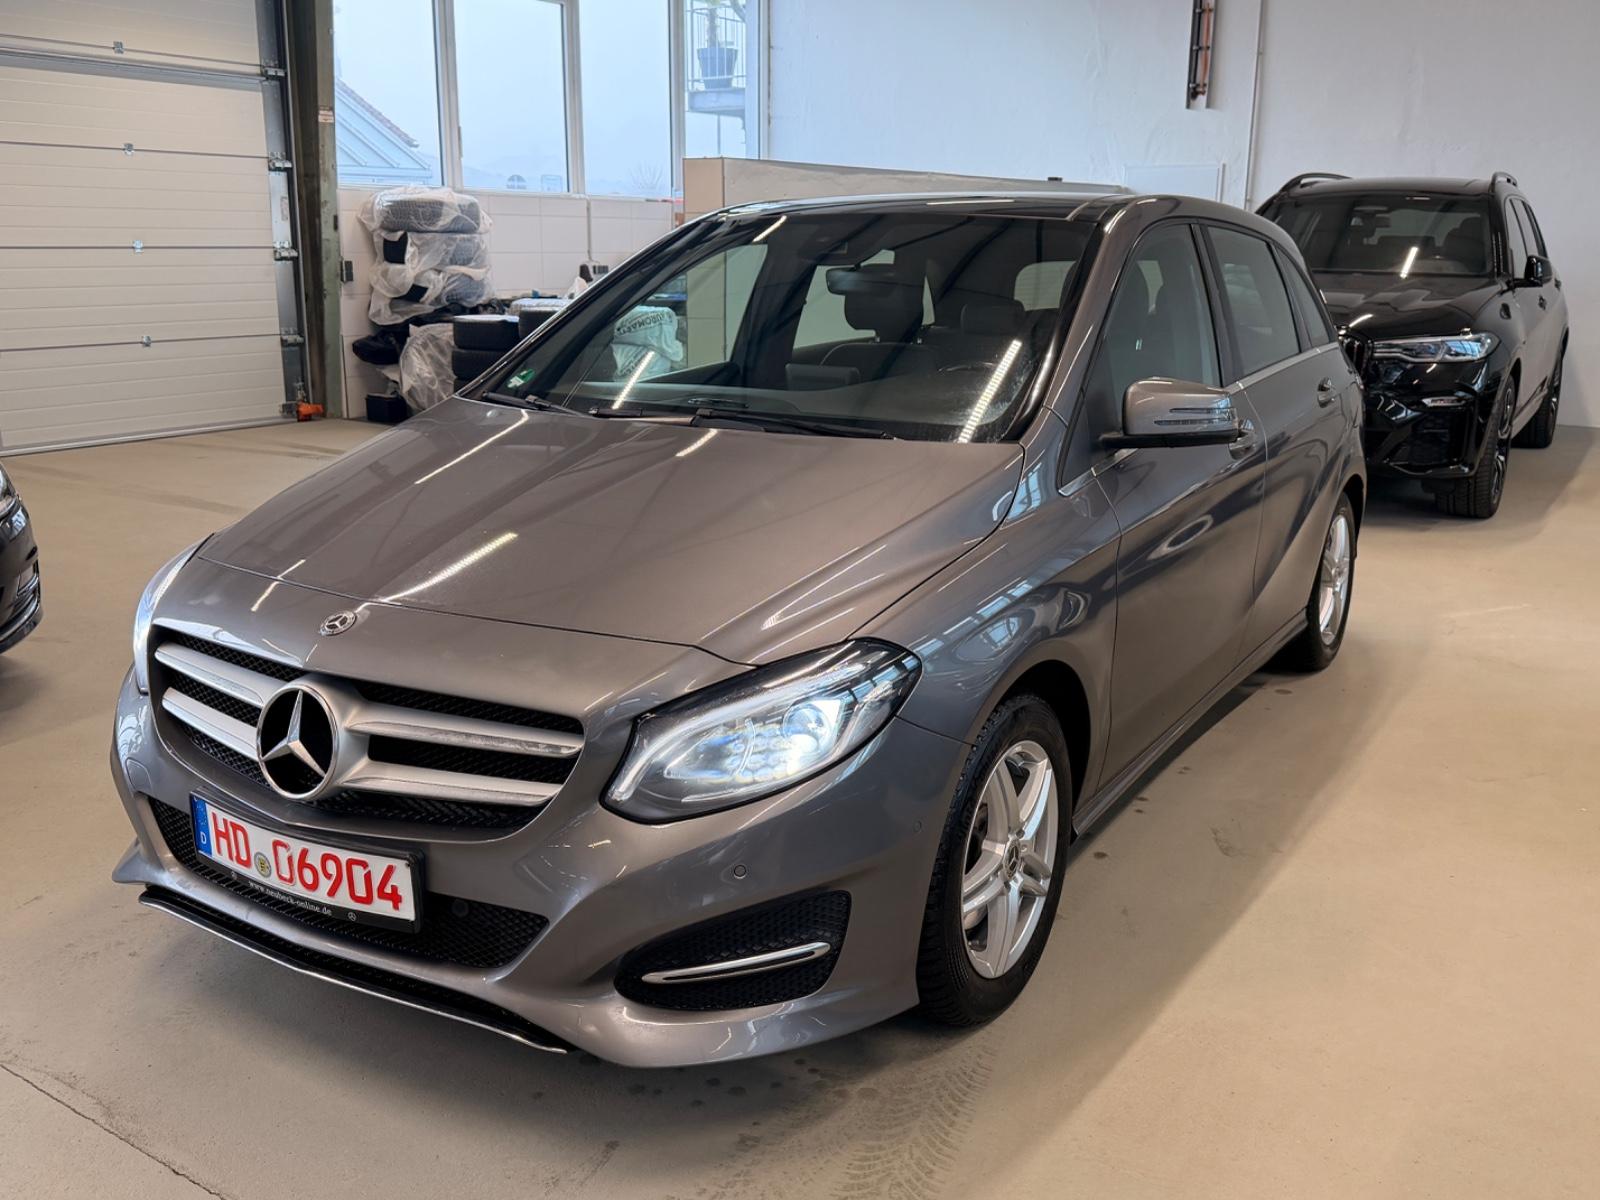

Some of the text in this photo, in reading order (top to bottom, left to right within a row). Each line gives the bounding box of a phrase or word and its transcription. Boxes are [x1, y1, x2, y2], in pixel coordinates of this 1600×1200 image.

[200, 831, 207, 845] D
[211, 812, 402, 911] HD 06904
